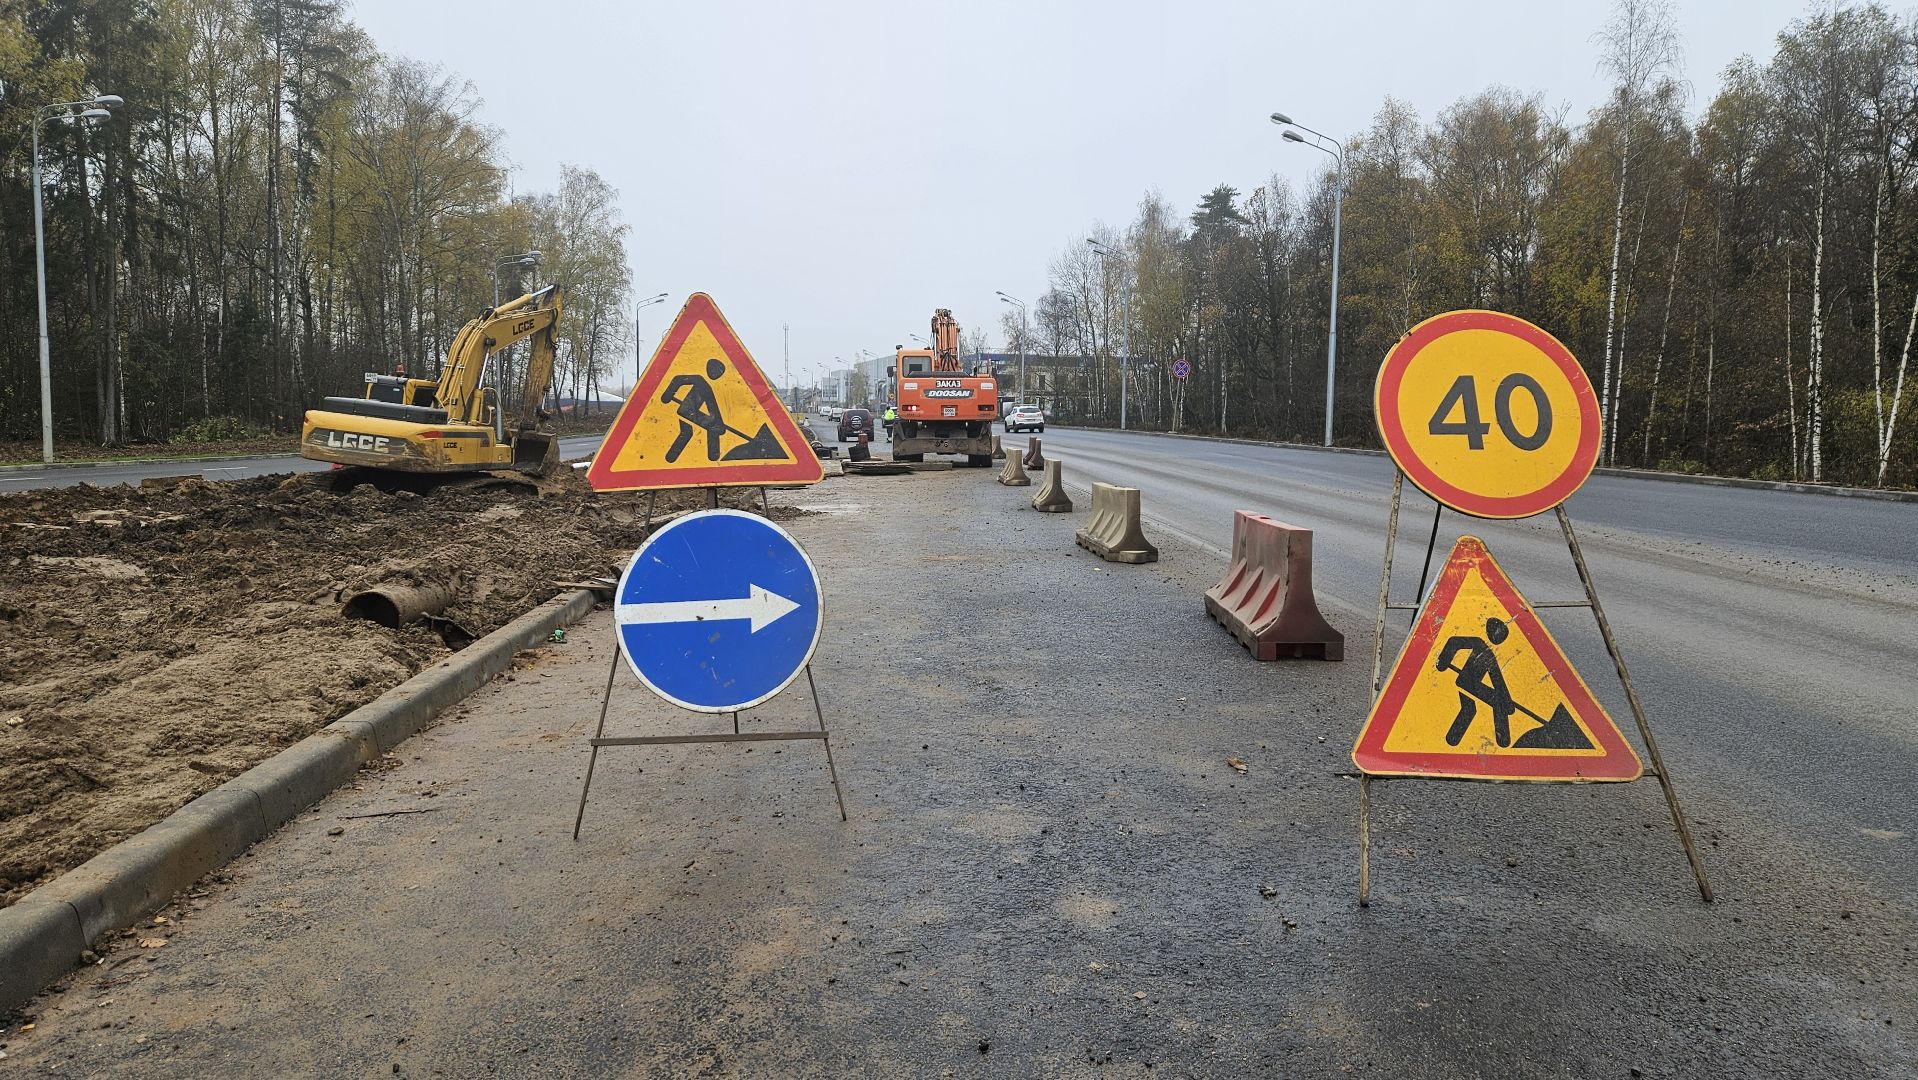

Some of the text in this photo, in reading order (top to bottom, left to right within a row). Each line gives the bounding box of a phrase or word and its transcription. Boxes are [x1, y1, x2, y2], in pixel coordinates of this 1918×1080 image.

[512, 318, 535, 336] LGCE
[936, 380, 961, 388] ЗАКАЗ
[1428, 372, 1553, 451] 40
[327, 431, 390, 454] LGCE
